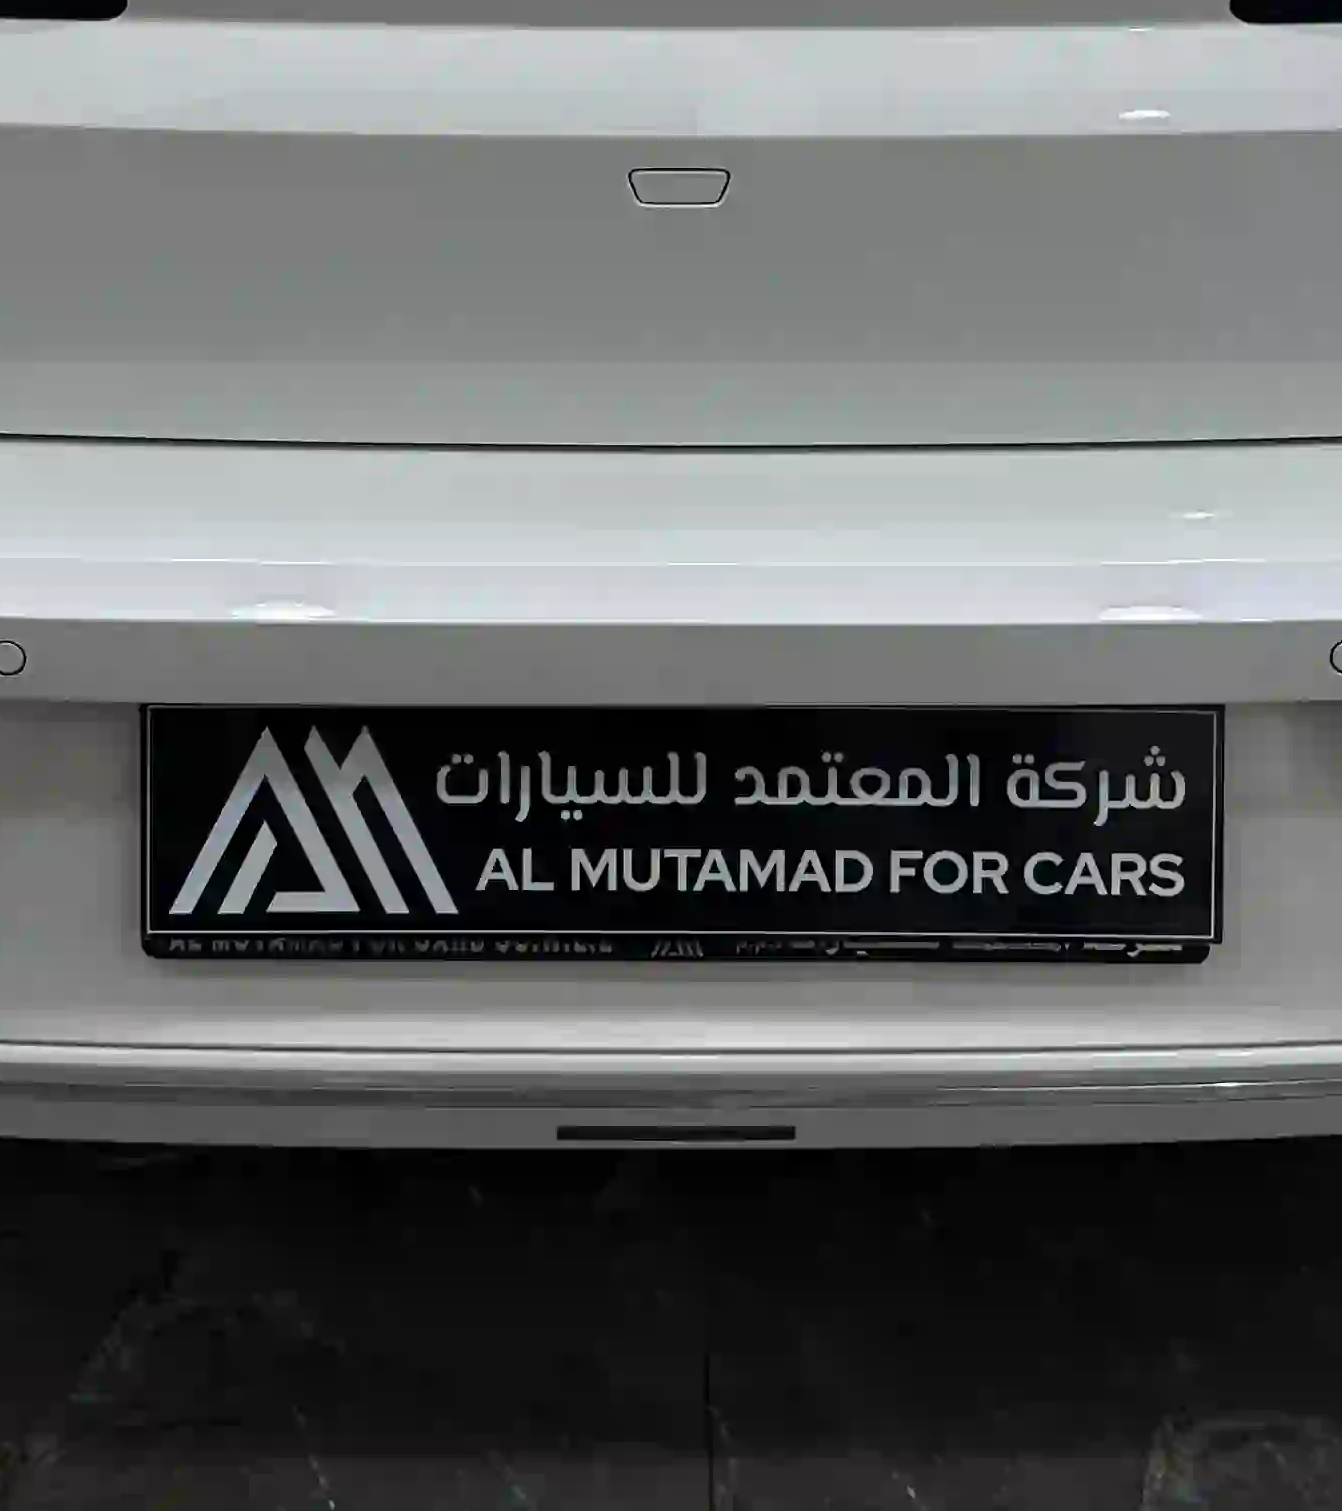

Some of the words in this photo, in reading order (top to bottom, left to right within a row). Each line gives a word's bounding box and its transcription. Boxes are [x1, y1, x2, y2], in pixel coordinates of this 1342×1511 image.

[435, 751, 707, 822] للسيارات
[734, 752, 980, 807] المعتمد
[1006, 745, 1186, 827] شركة
[475, 847, 554, 892] AL
[571, 848, 874, 893] MUTAMAD
[889, 849, 1010, 895] FOR
[1023, 851, 1186, 897] CARS
